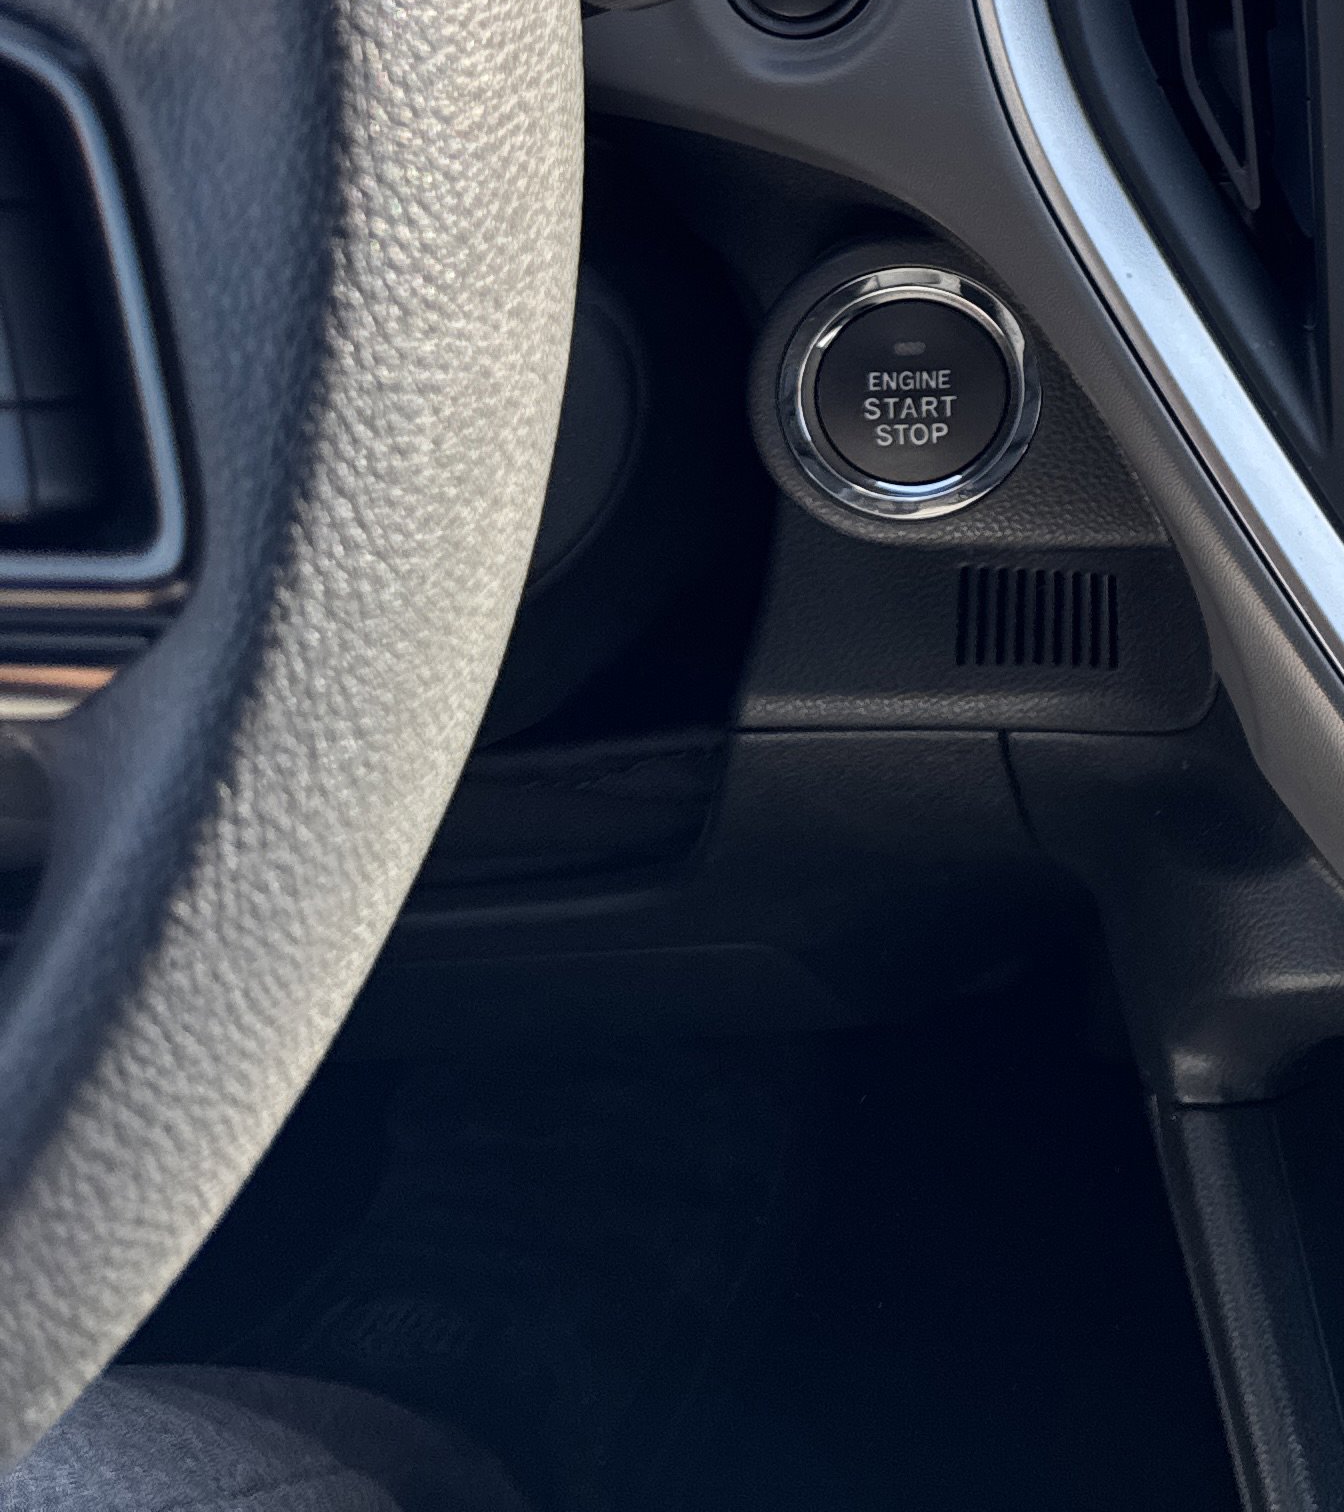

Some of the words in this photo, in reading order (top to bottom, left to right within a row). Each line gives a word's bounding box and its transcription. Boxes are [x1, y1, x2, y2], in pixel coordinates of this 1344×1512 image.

[868, 369, 951, 391] ENGINE
[863, 395, 958, 420] START
[876, 422, 949, 447] STOP
